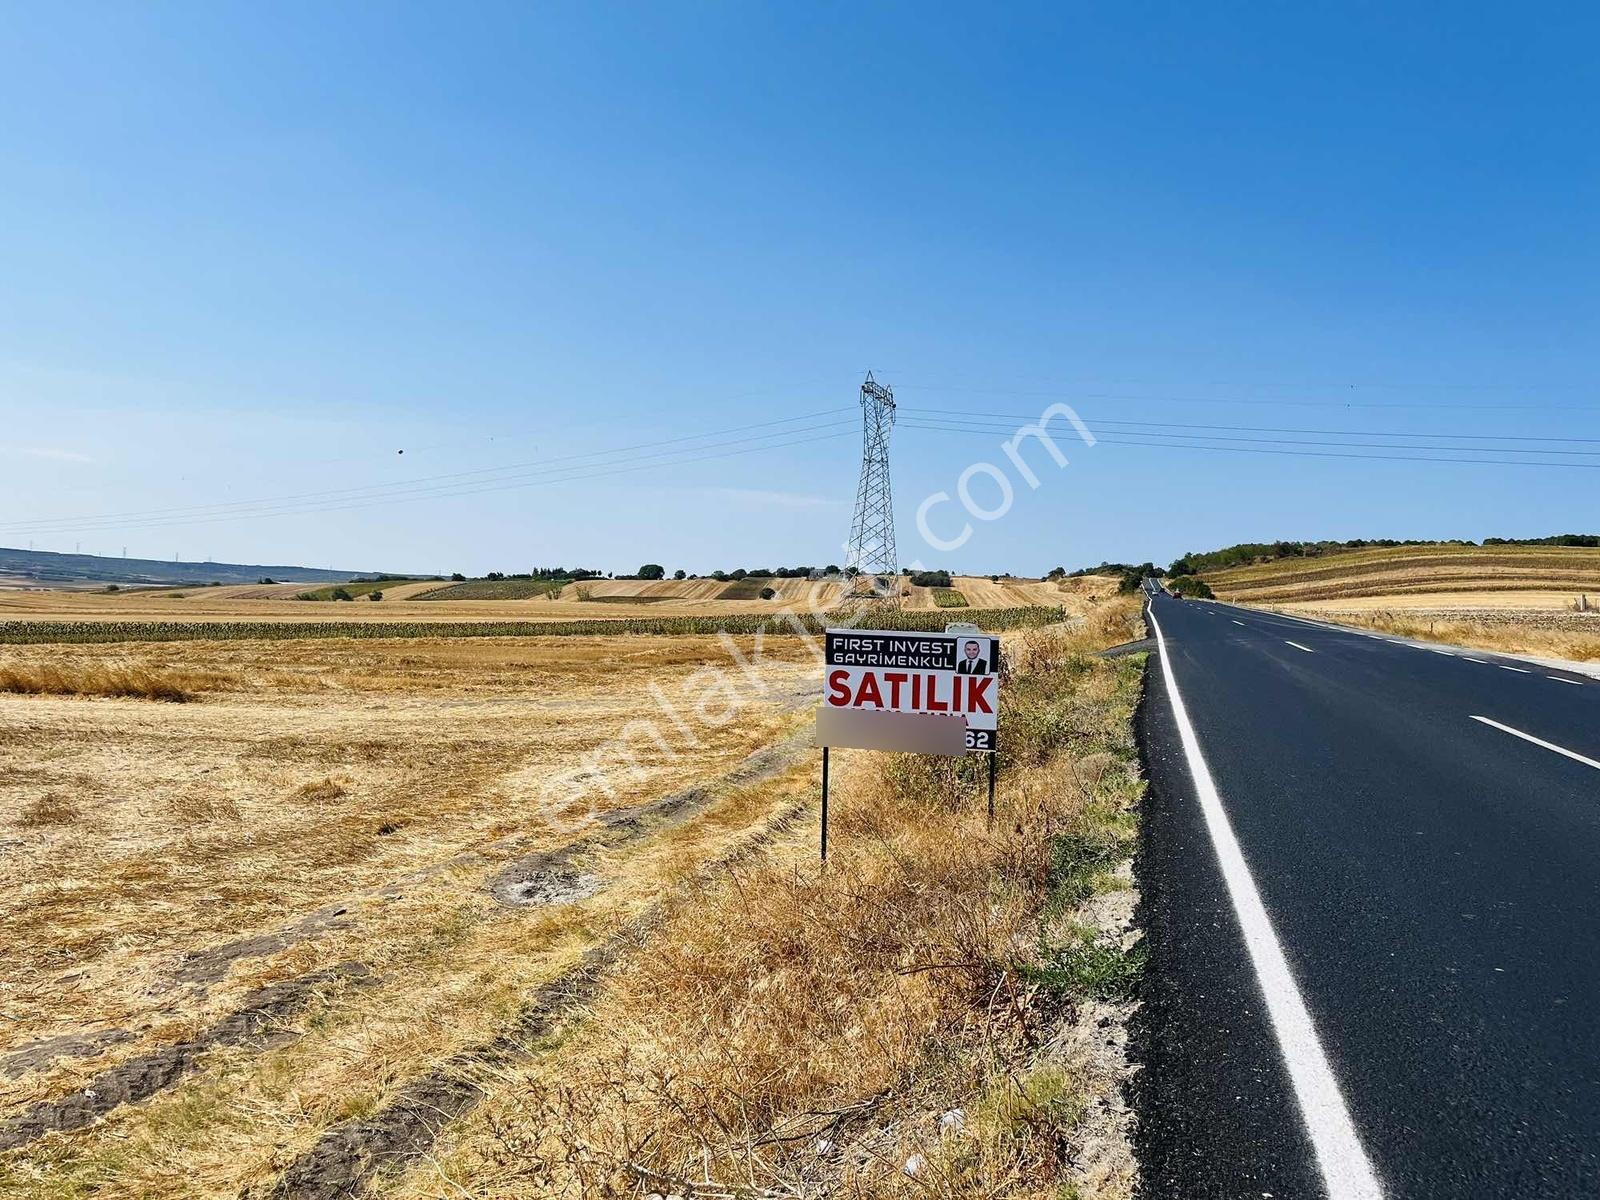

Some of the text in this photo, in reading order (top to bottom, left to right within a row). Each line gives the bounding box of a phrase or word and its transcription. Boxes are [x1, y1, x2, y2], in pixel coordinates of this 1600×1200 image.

[833, 637, 955, 655] FIRST INVEST
[833, 652, 954, 668] GAYRİMENKUL
[827, 669, 994, 714] SATILIK
